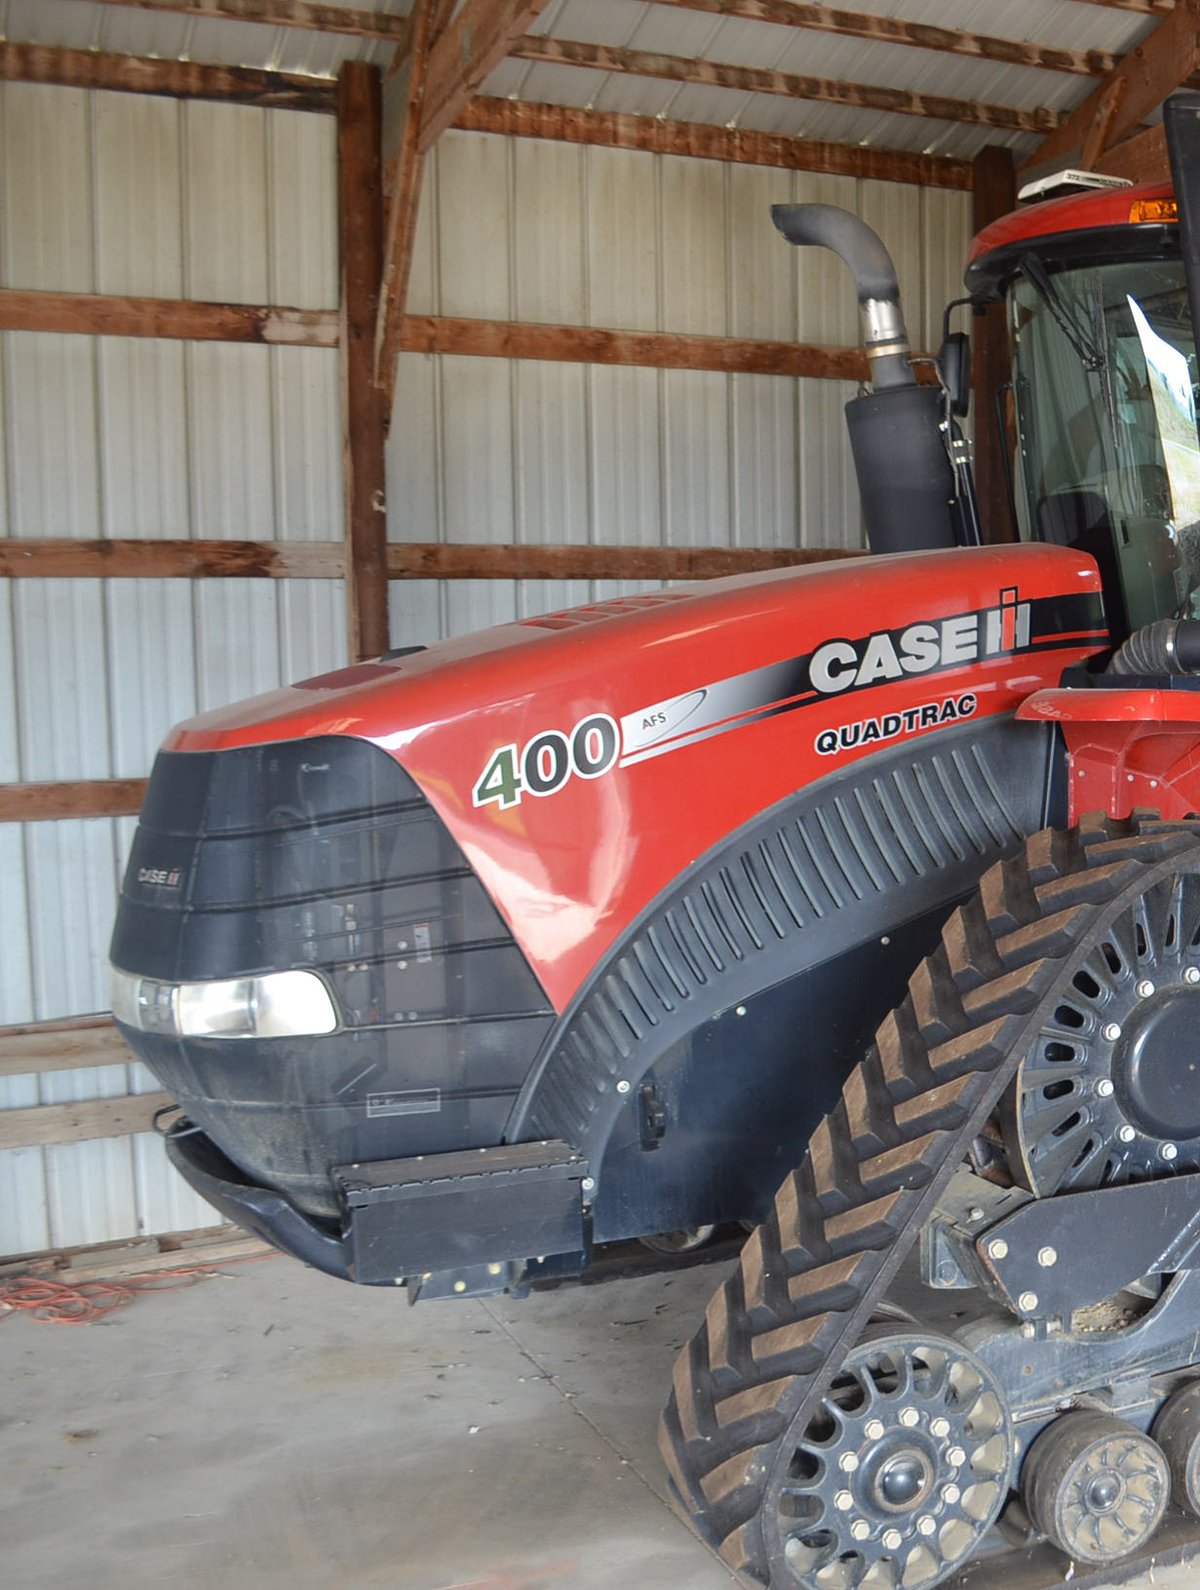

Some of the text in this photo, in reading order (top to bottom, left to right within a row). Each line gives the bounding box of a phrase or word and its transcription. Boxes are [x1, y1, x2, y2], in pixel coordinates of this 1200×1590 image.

[809, 614, 979, 693] CASE
[643, 711, 667, 730] AFS
[815, 693, 977, 756] QUADTRAC
[473, 713, 620, 810] 400
